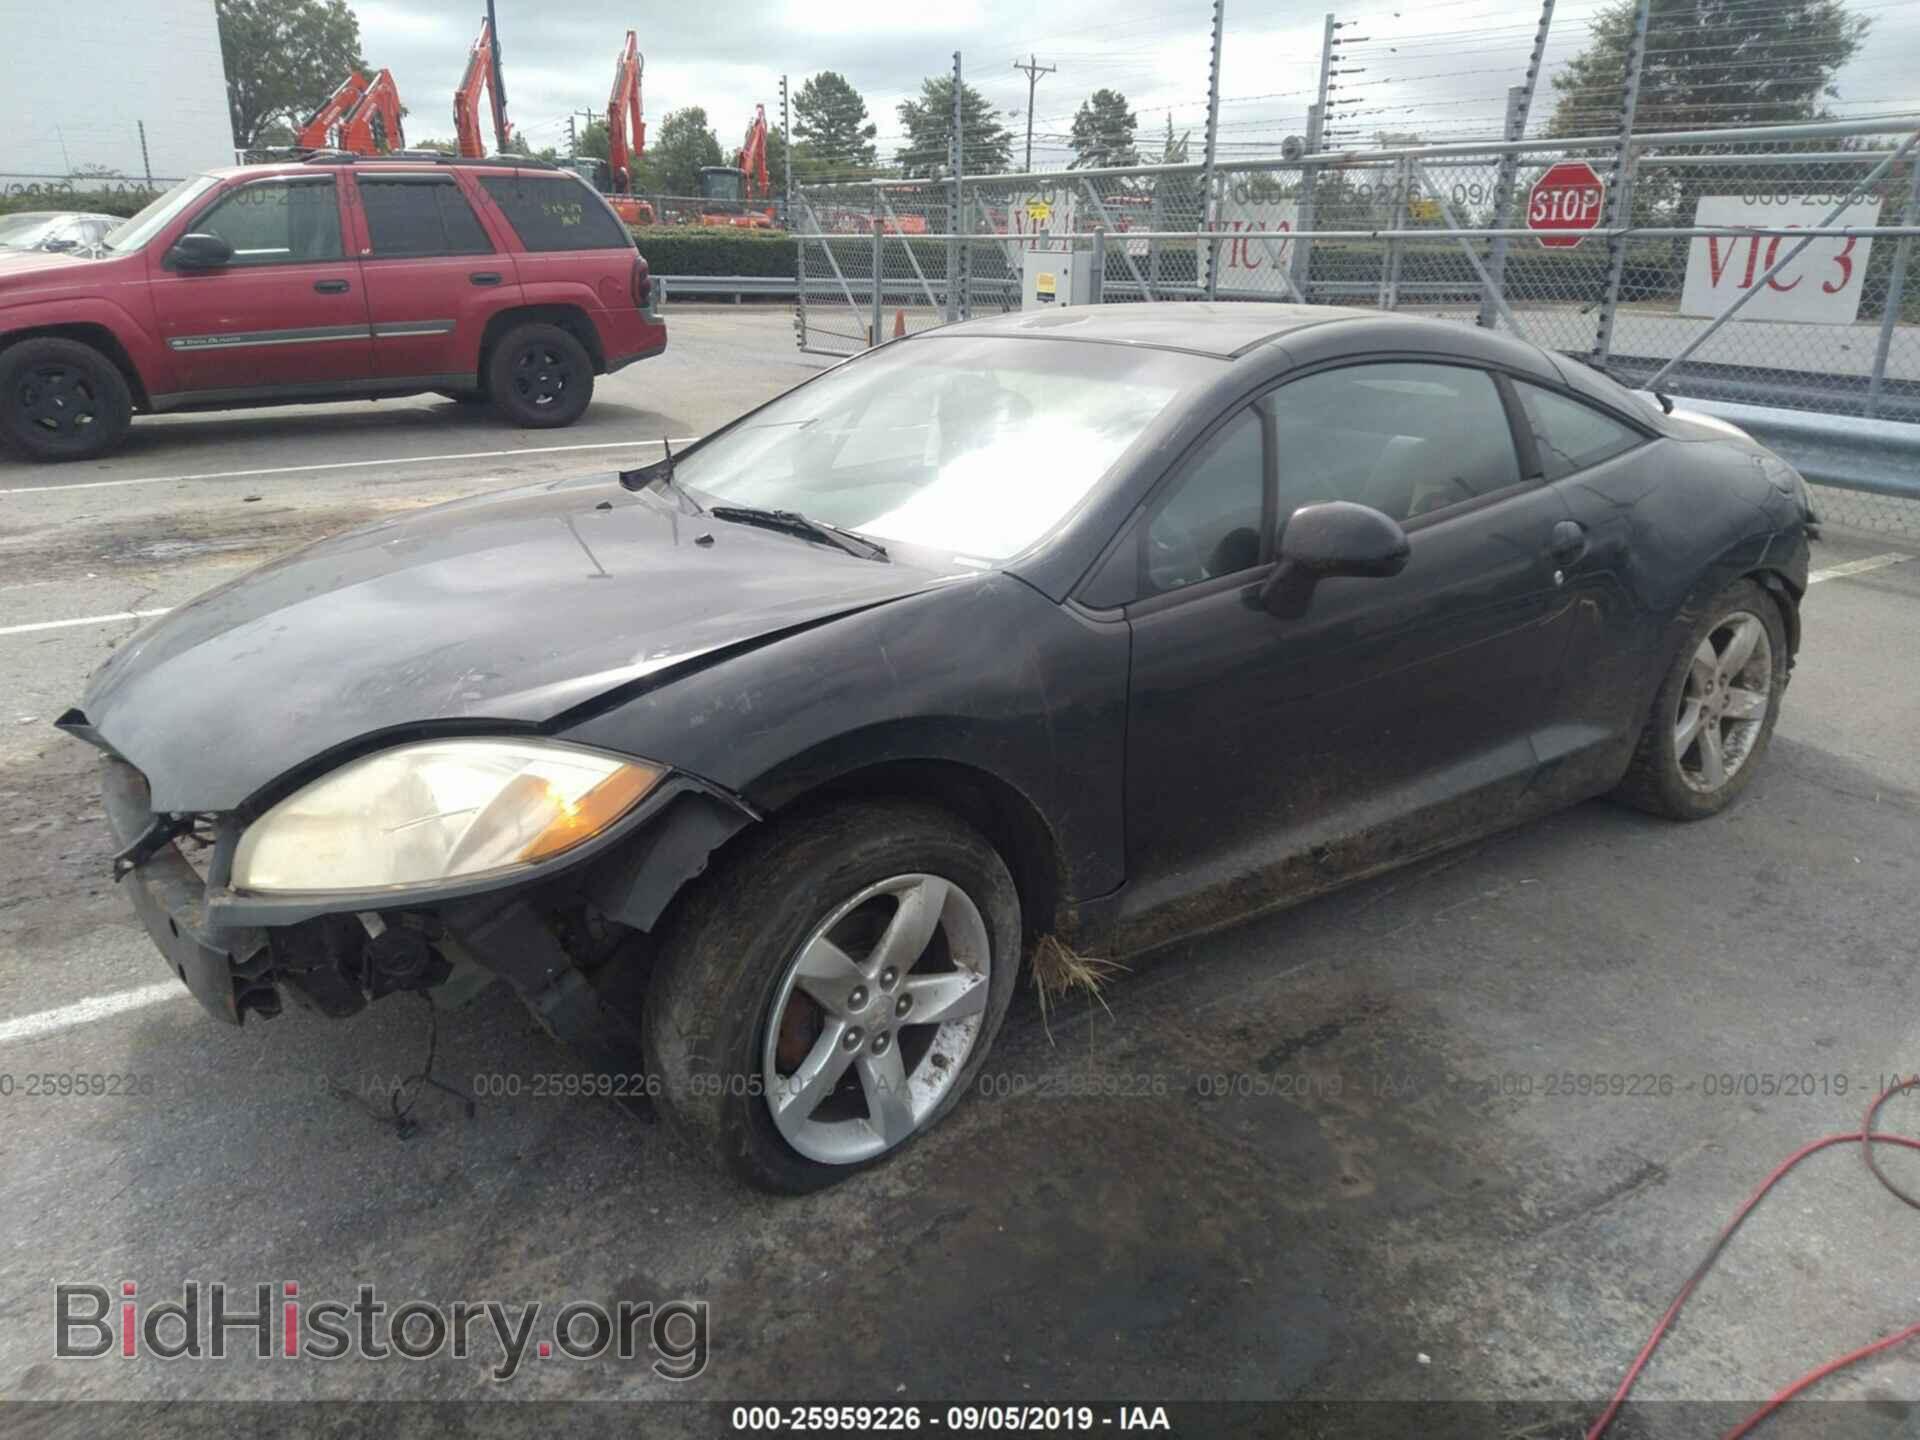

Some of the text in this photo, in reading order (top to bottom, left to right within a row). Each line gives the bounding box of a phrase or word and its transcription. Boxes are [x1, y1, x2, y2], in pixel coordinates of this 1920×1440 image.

[1532, 190, 1599, 221] STOP
[1697, 225, 1857, 294] VIC 3
